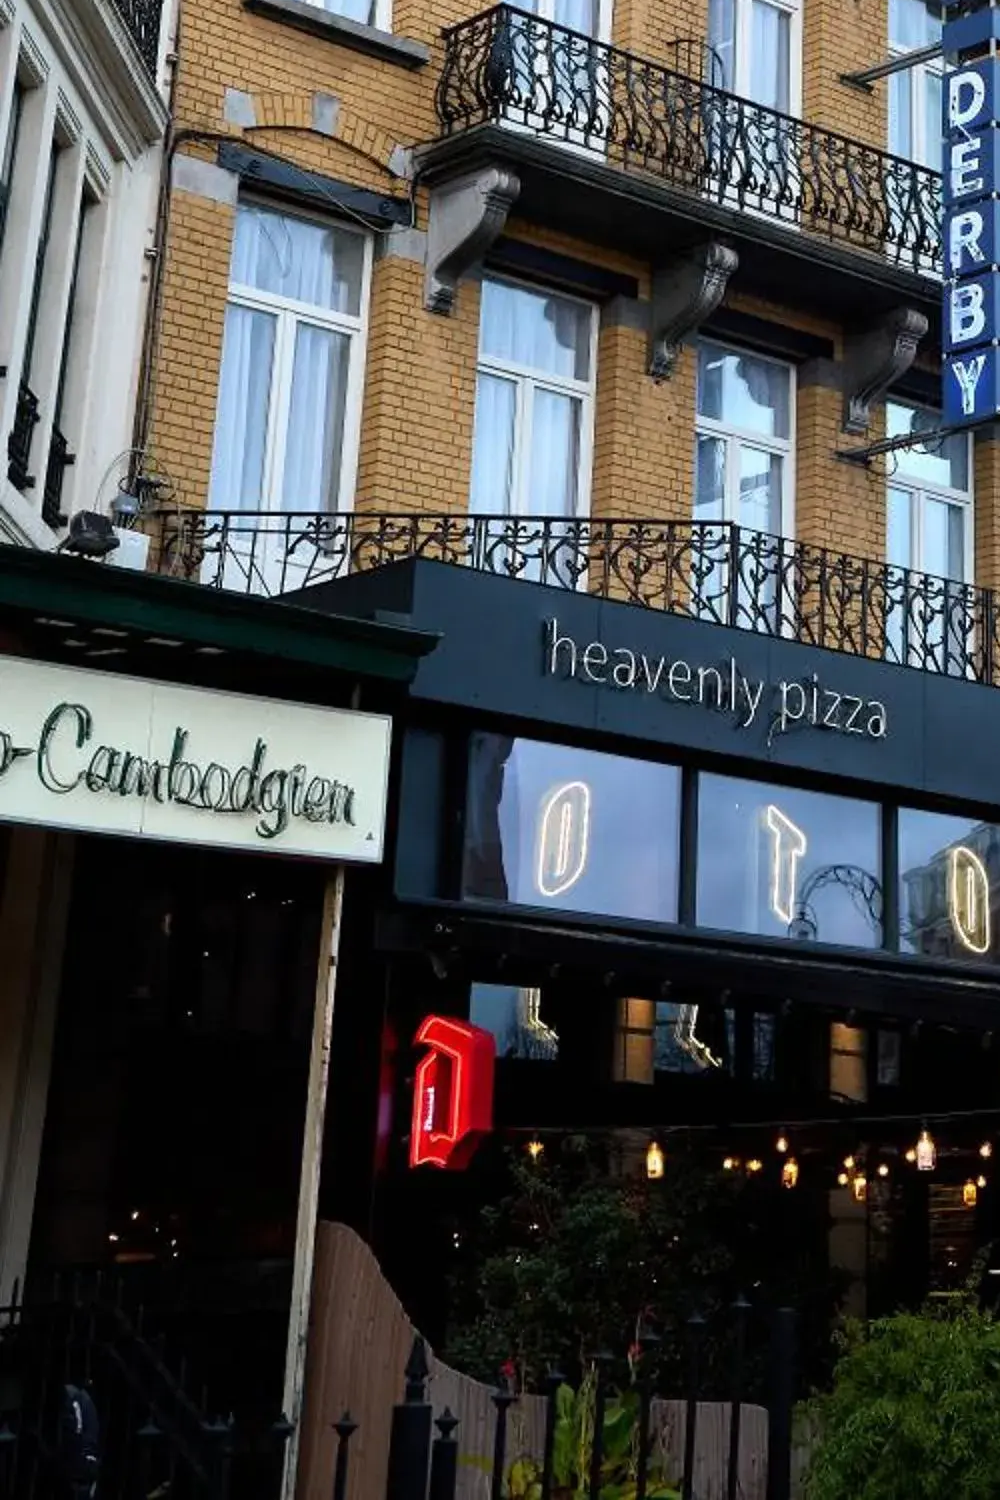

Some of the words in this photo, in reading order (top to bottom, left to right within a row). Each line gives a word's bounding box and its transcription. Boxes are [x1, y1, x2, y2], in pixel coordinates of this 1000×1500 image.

[950, 71, 986, 416] DERBY
[549, 617, 765, 729] heavenly
[776, 672, 888, 739] pizza
